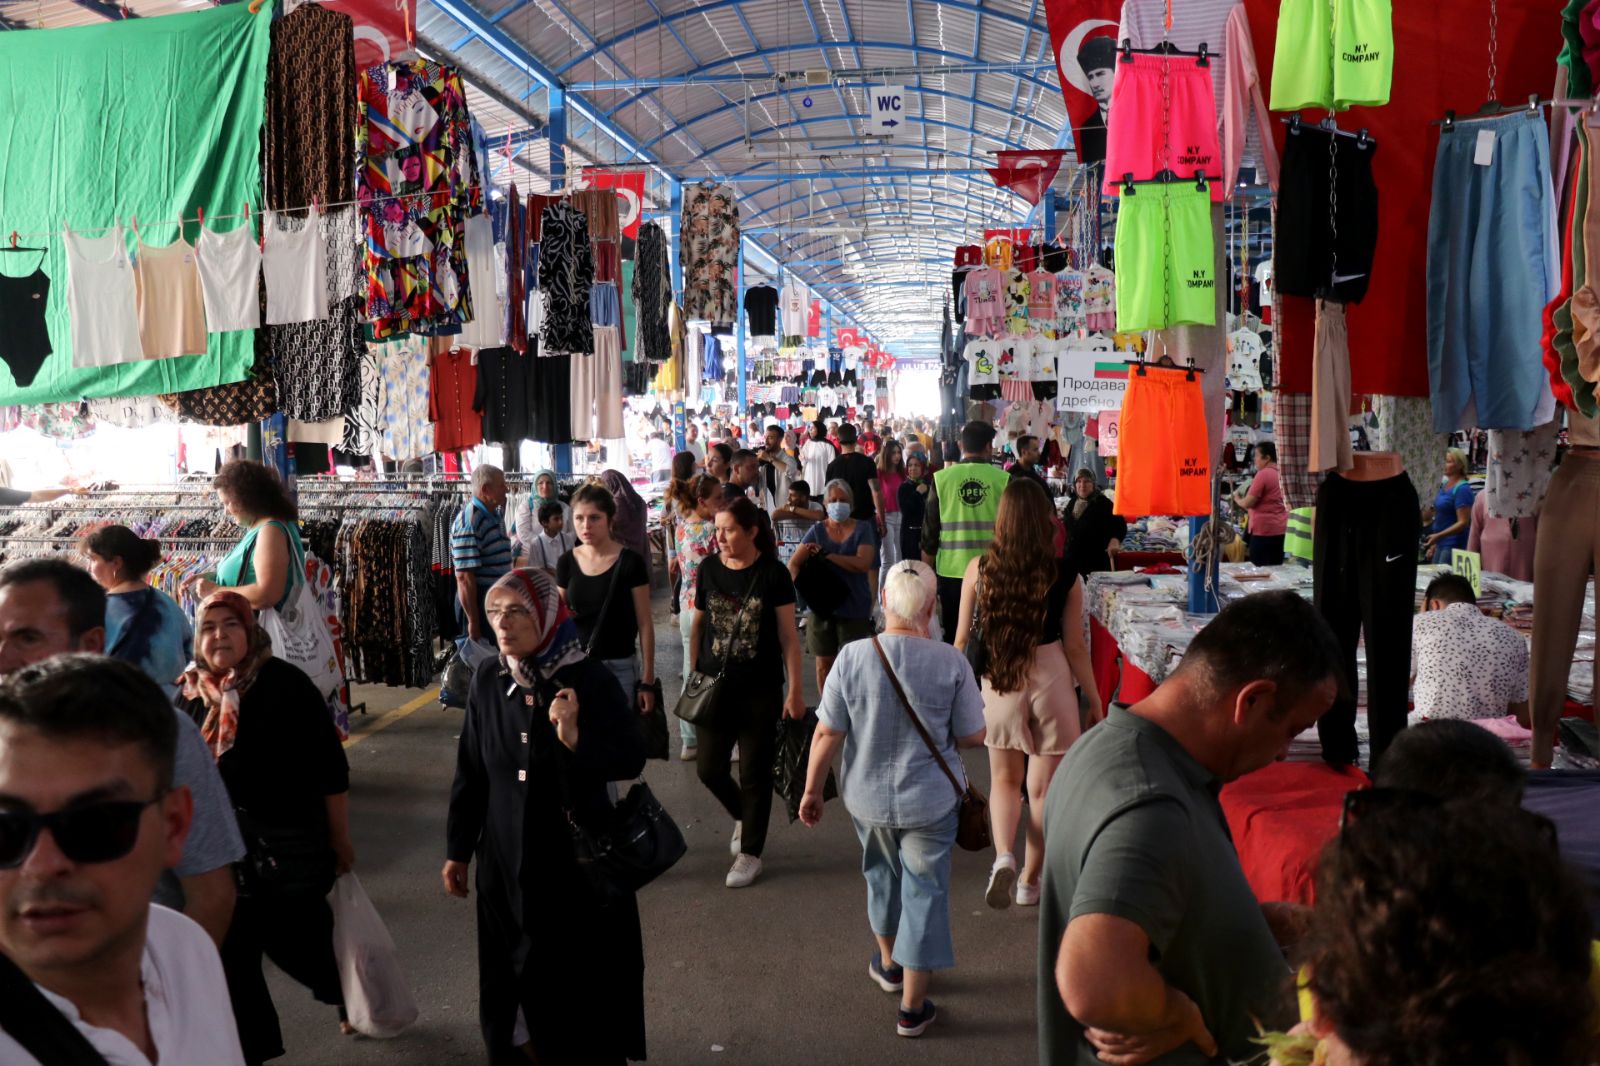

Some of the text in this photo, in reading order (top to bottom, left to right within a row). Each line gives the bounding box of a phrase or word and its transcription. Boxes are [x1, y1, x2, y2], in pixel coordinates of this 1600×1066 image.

[1342, 51, 1380, 63] COMPANY
[877, 95, 902, 112] WC
[1063, 376, 1130, 391] Продава
[1061, 396, 1115, 408] дребно
